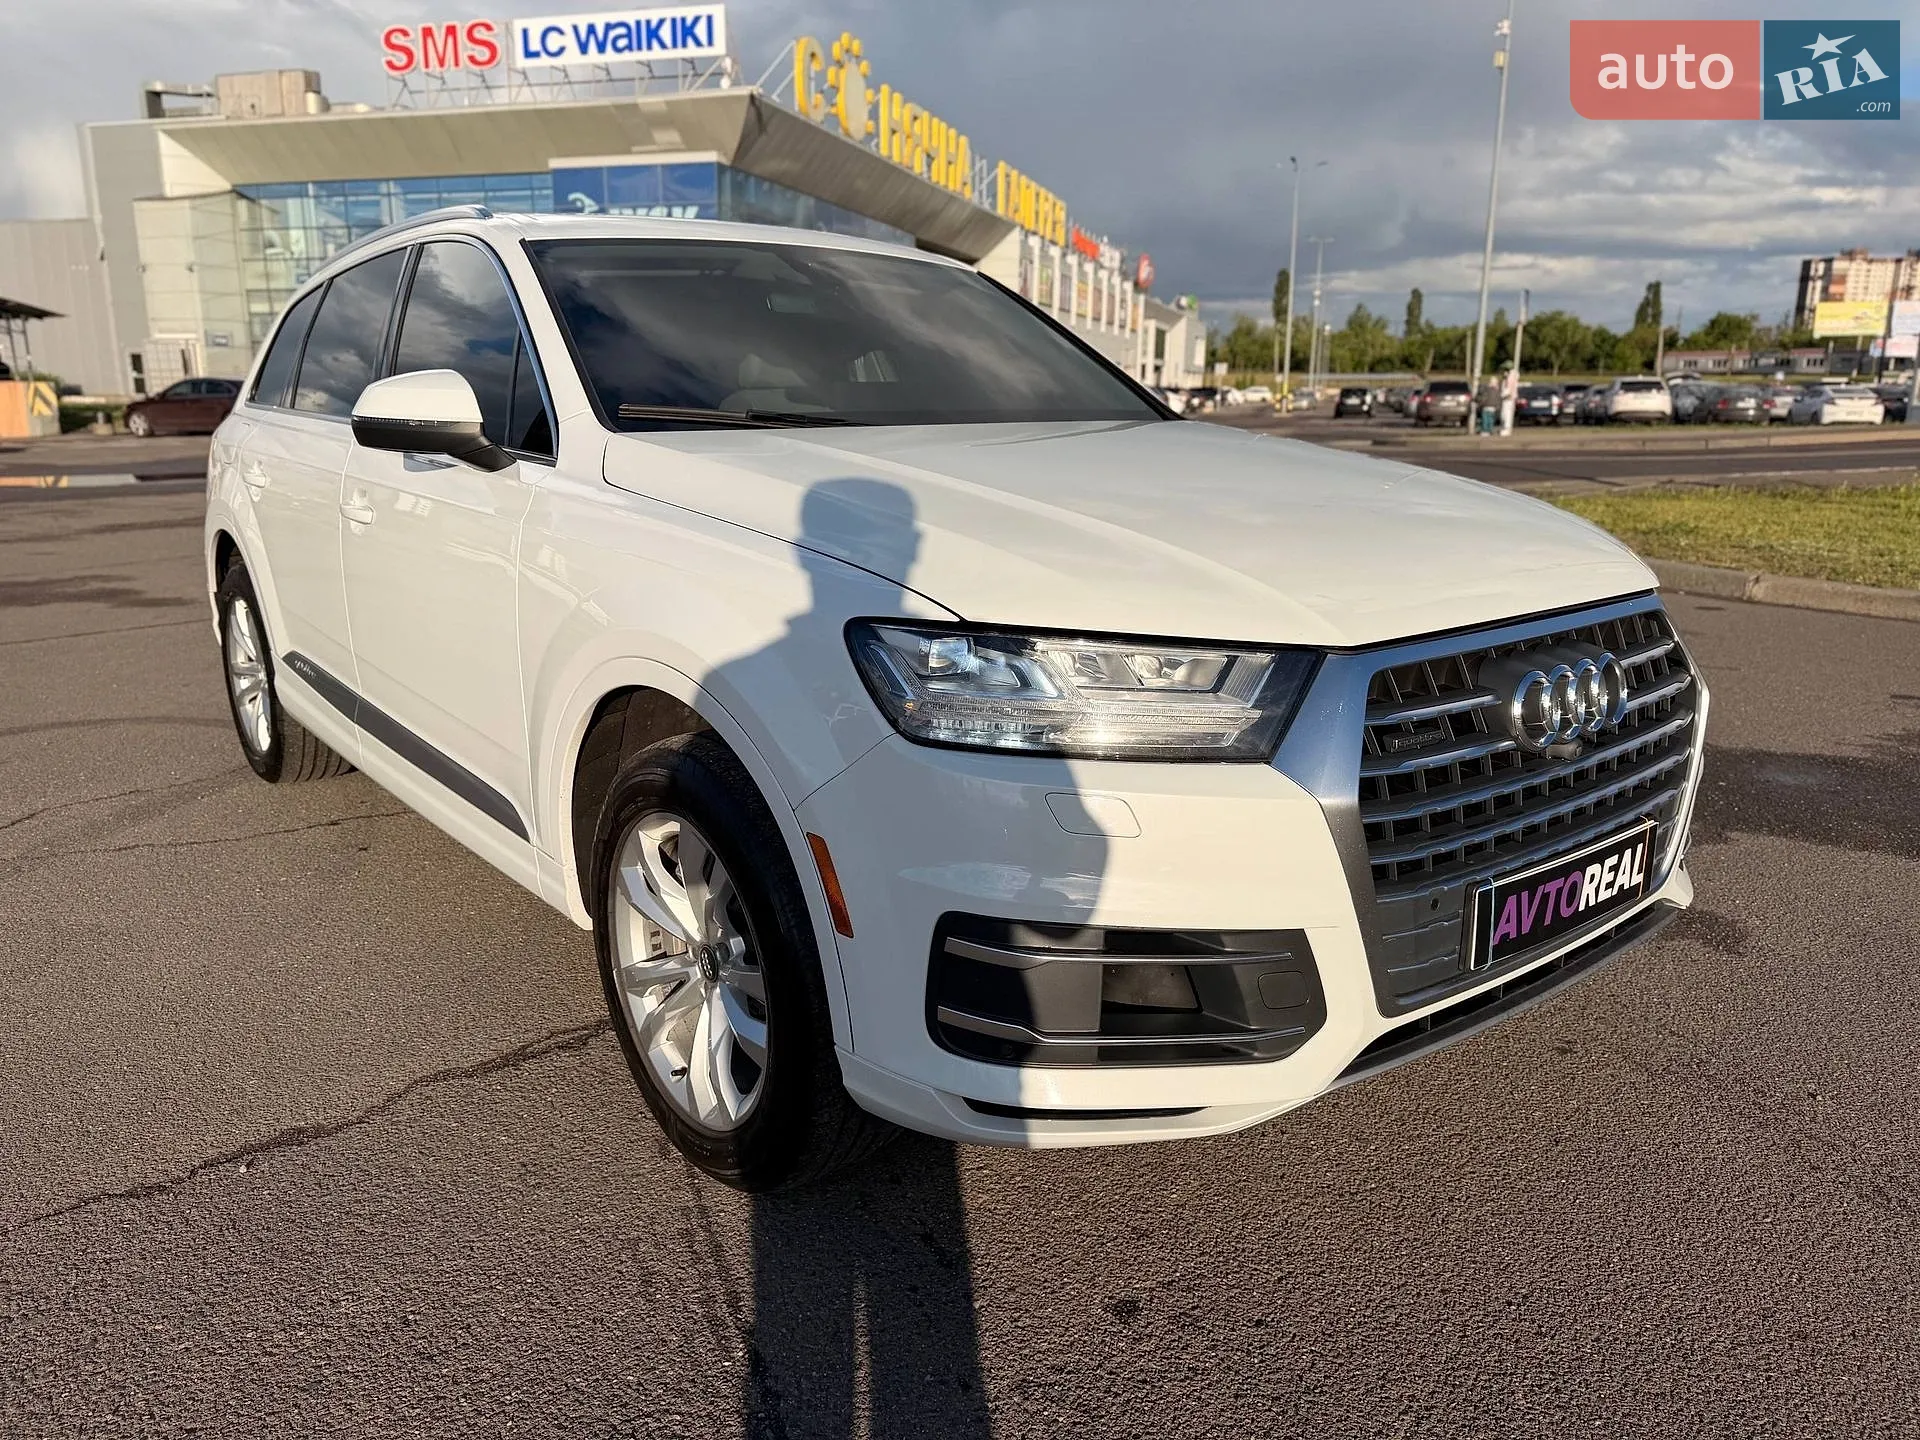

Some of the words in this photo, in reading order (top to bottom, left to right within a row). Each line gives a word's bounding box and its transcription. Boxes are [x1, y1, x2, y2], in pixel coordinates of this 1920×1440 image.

[382, 19, 501, 73] SMS
[521, 26, 566, 59] LC
[1493, 842, 1644, 945] AVTOREAL
